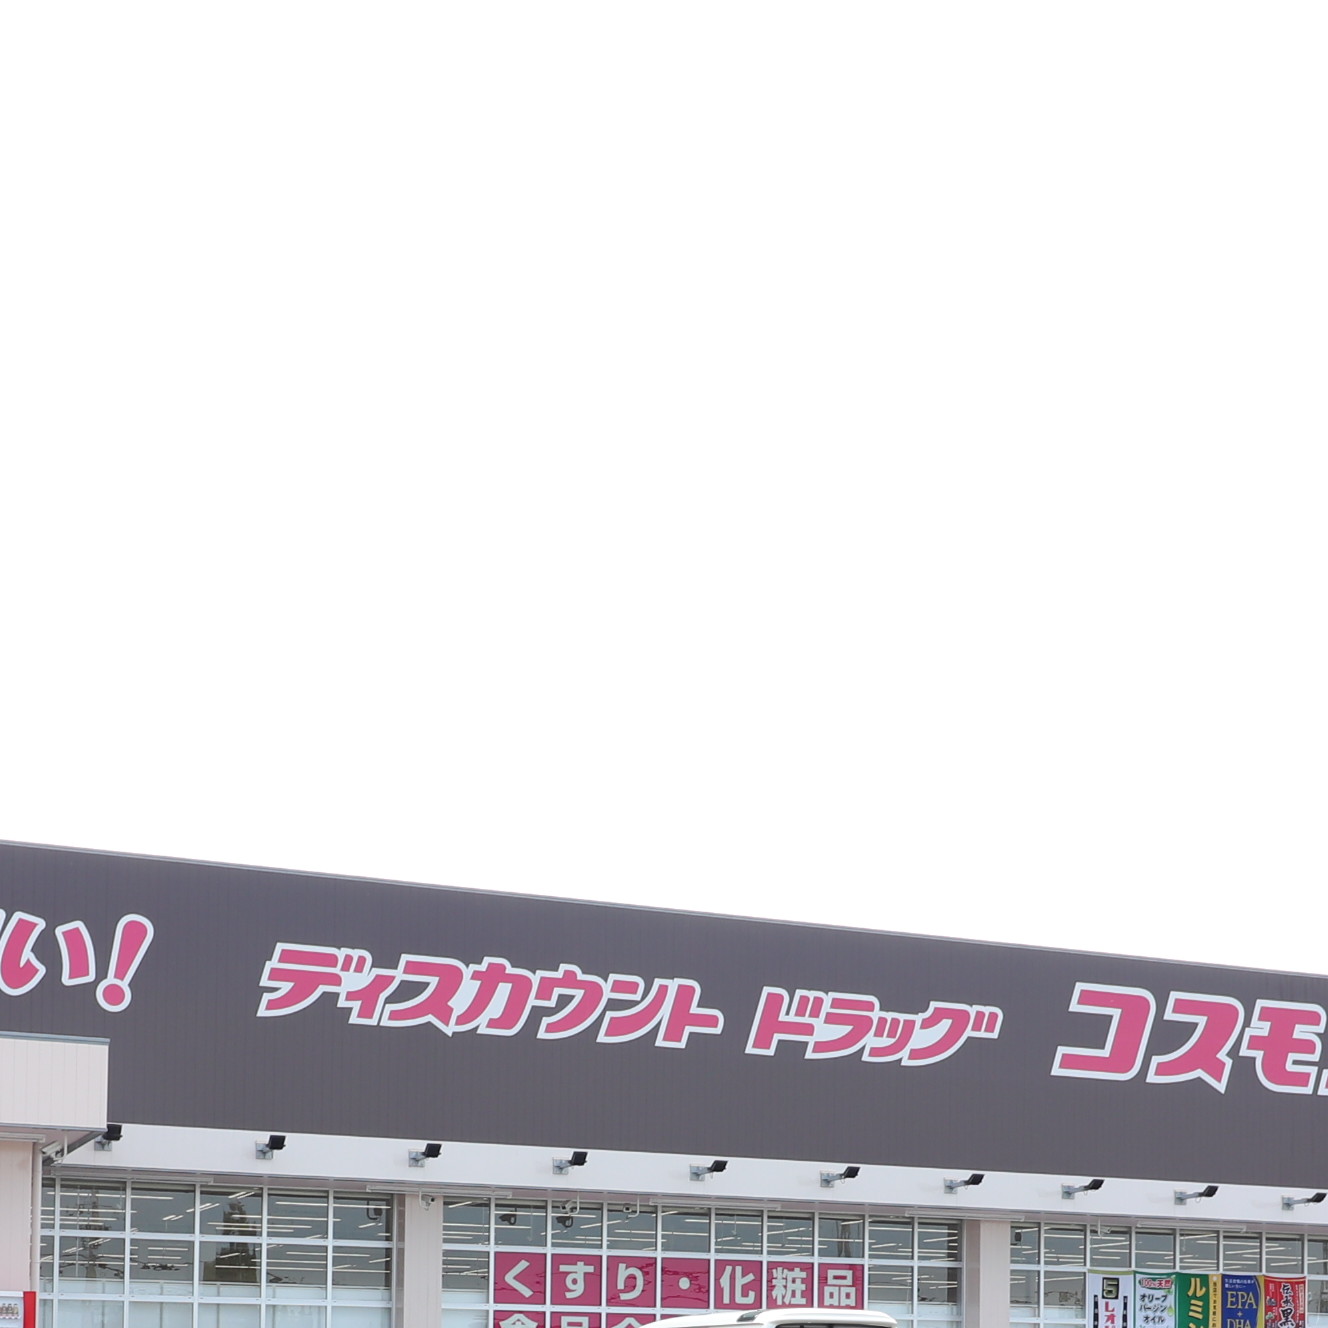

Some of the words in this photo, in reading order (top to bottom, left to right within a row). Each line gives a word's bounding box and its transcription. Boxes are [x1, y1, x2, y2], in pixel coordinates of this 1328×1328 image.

[256, 942, 724, 1049] ディスカウント
[745, 987, 1003, 1066] ドラッグ
[504, 1259, 856, 1307] くすり・化粧品
[1226, 1291, 1257, 1309] EPA
[1143, 1315, 1166, 1324] オイル
